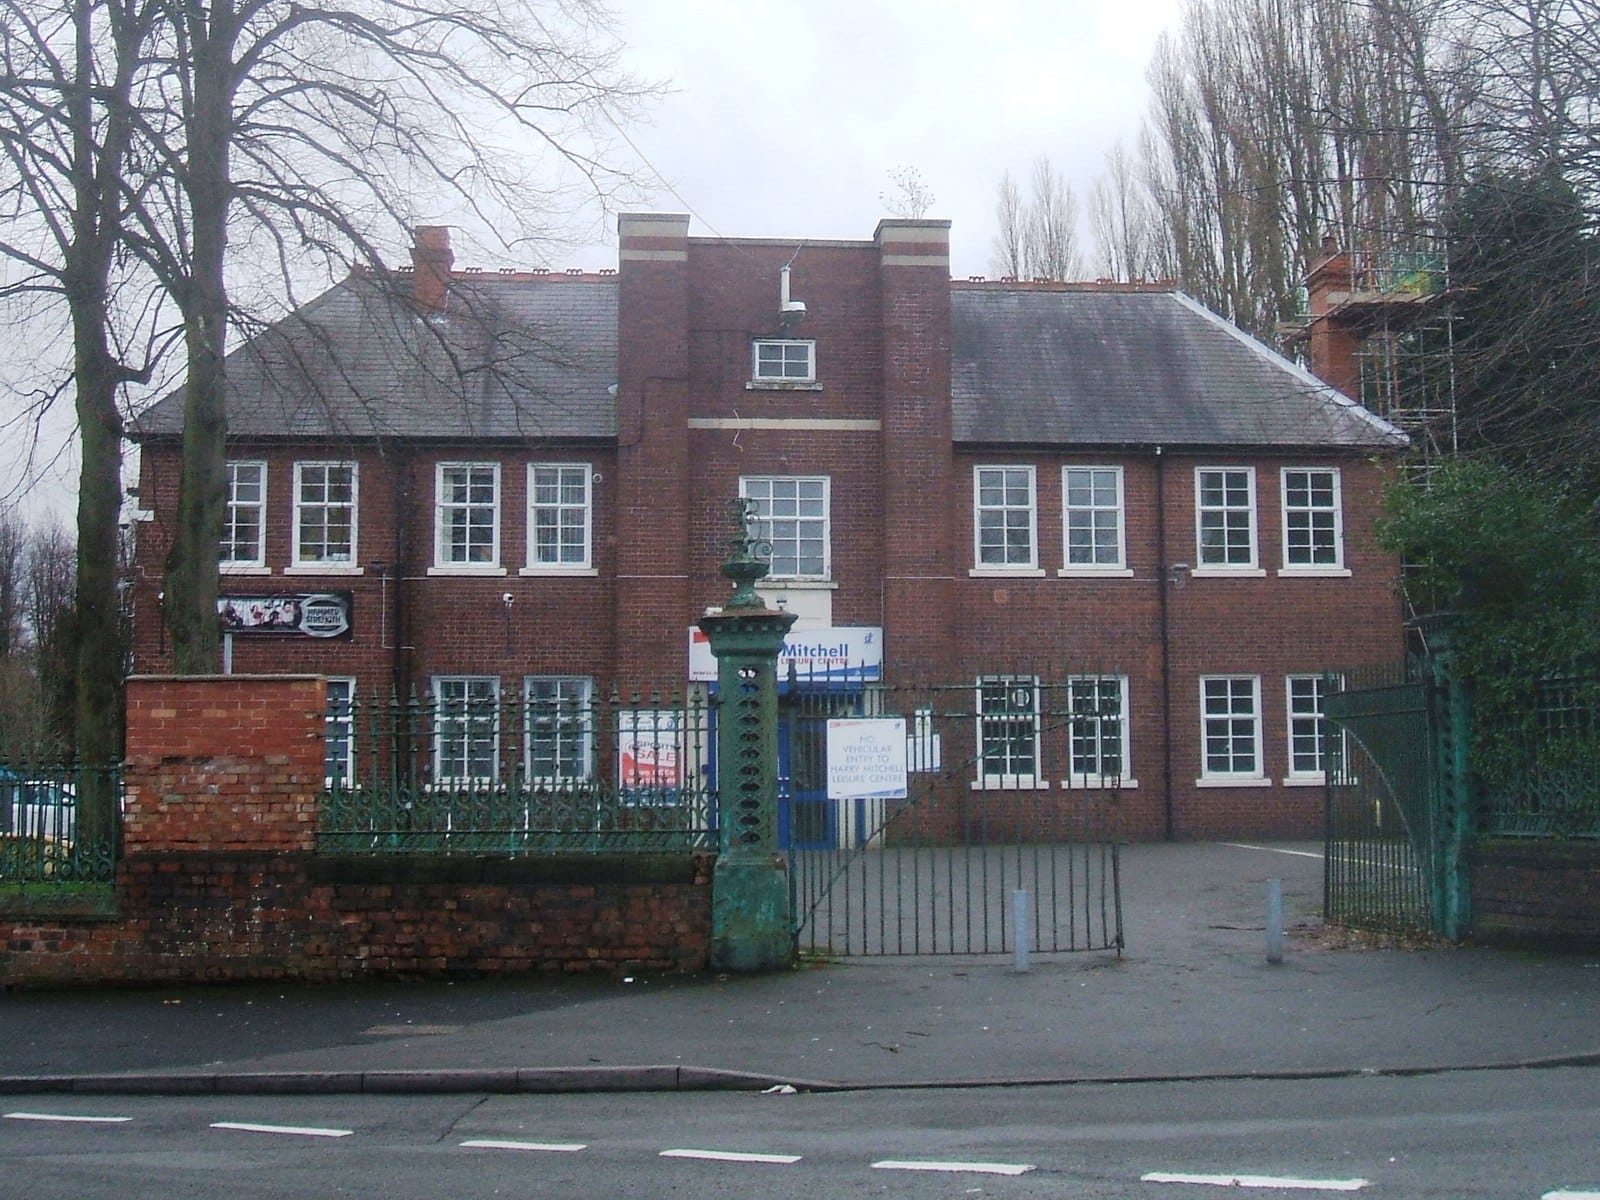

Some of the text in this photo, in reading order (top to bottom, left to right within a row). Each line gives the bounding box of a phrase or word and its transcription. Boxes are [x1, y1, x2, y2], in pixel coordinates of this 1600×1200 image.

[782, 643, 848, 657] Mitchell
[780, 657, 813, 665] LEUR
[859, 735, 875, 743] NO
[842, 745, 892, 753] VEHICULAR
[846, 755, 890, 763] ENTRY TO
[830, 764, 904, 773] HARRY MITCHELL
[831, 774, 903, 783] LEISURE CENTRE
